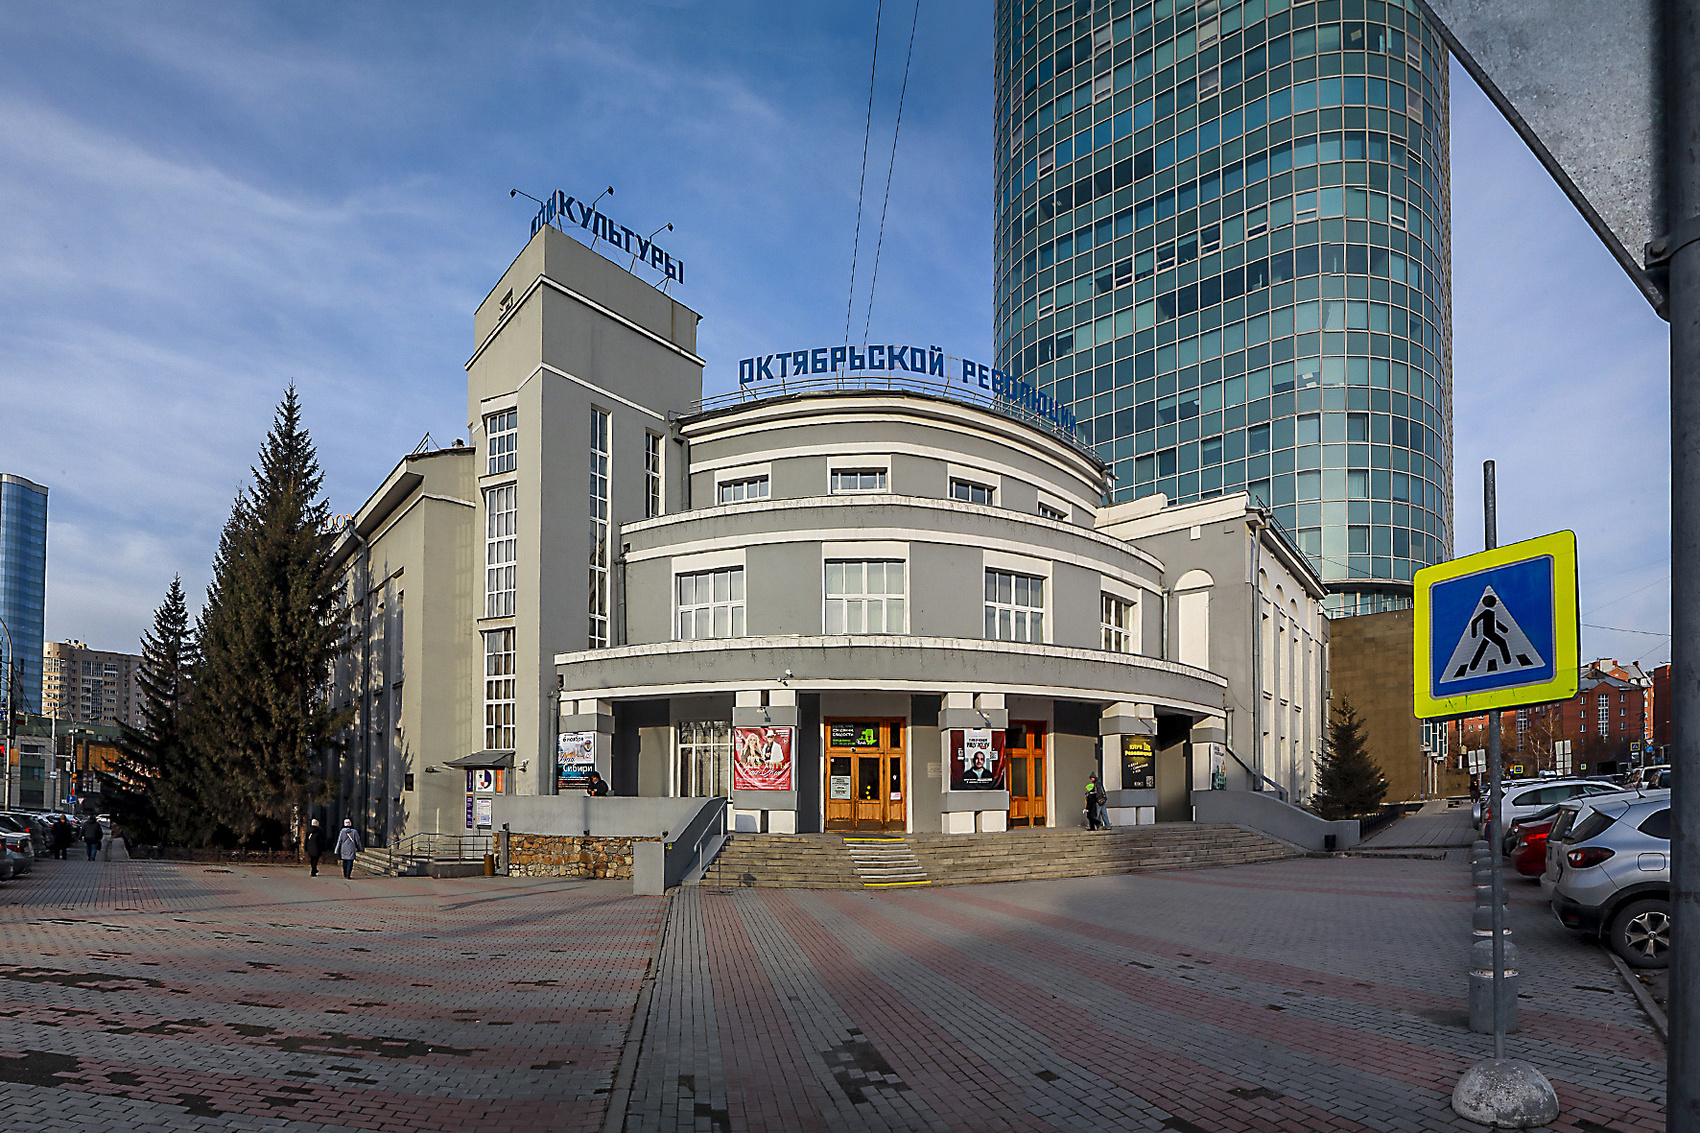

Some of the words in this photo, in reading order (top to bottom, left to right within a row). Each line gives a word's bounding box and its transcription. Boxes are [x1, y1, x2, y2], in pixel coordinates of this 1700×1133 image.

[531, 189, 557, 240] ДОМ
[558, 189, 684, 285] КУЛЬТУРЫ
[739, 345, 945, 384] ОКТЯБРЬСКОЙ
[962, 358, 1077, 437] РЕВОЛЮЦИИ
[562, 763, 593, 775] Сибири
